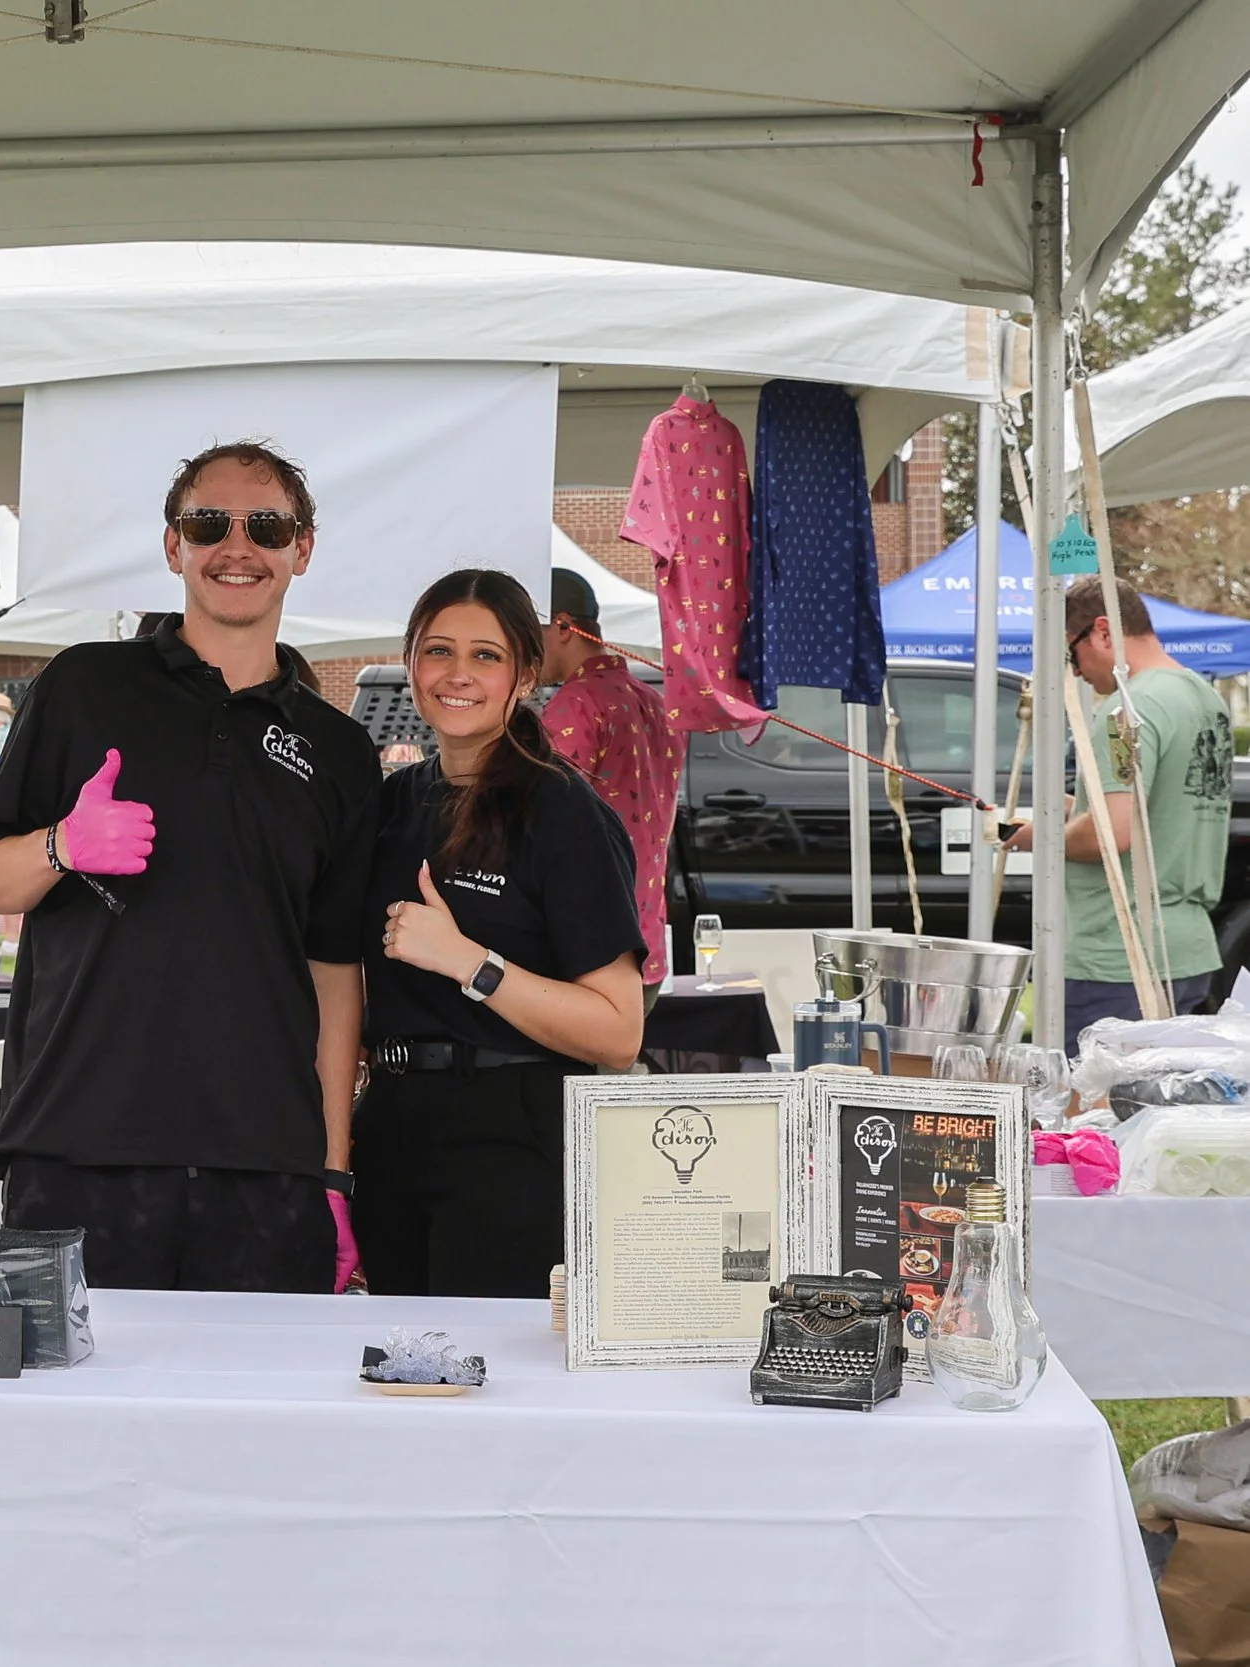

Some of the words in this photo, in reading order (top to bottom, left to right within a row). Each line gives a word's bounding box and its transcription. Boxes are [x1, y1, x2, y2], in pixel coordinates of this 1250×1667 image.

[652, 1117, 718, 1150] Edison
[854, 1123, 898, 1149] Edison
[913, 1114, 936, 1132] BE
[936, 1115, 996, 1138] BRIGHT
